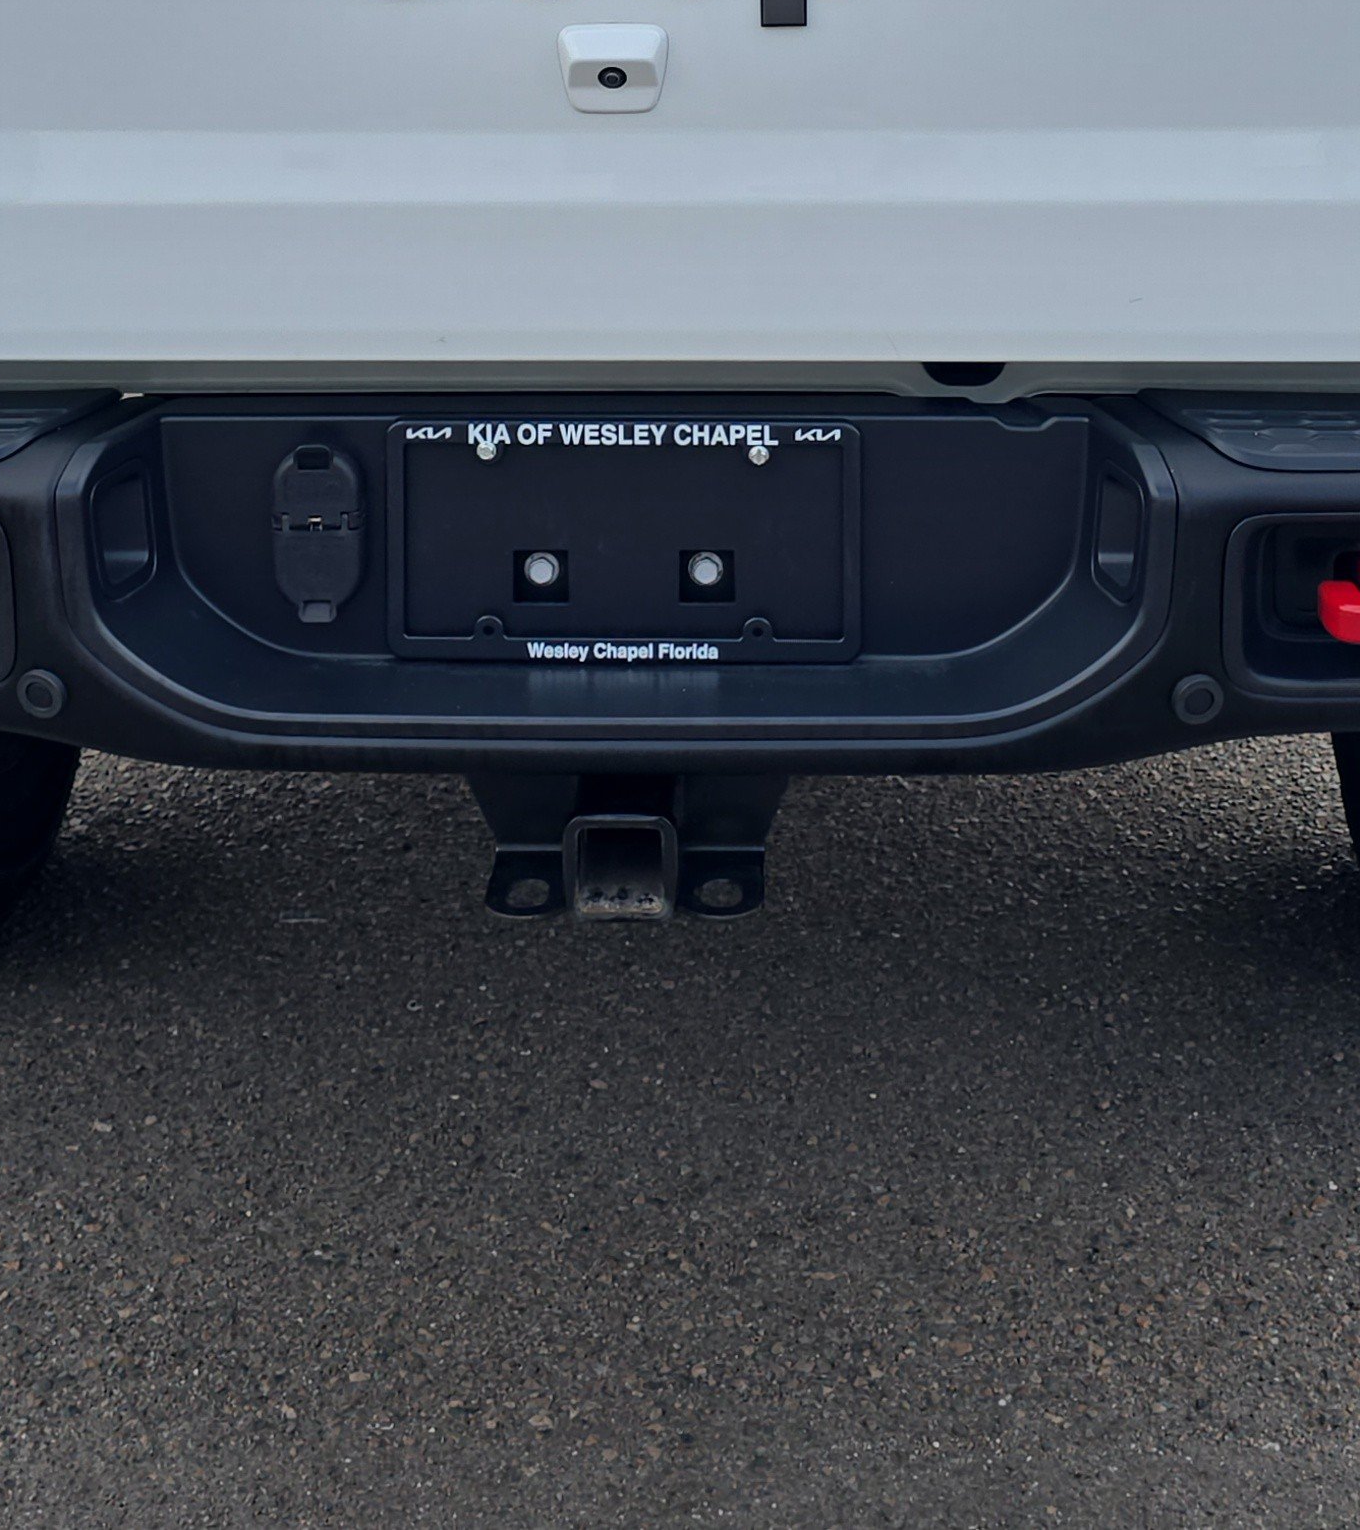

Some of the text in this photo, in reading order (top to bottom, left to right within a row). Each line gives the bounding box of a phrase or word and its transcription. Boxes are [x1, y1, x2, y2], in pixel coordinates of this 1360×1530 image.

[467, 423, 779, 447] KIA OF WESLEY CHAPEL
[527, 642, 719, 662] Wesley Chapel Florida
